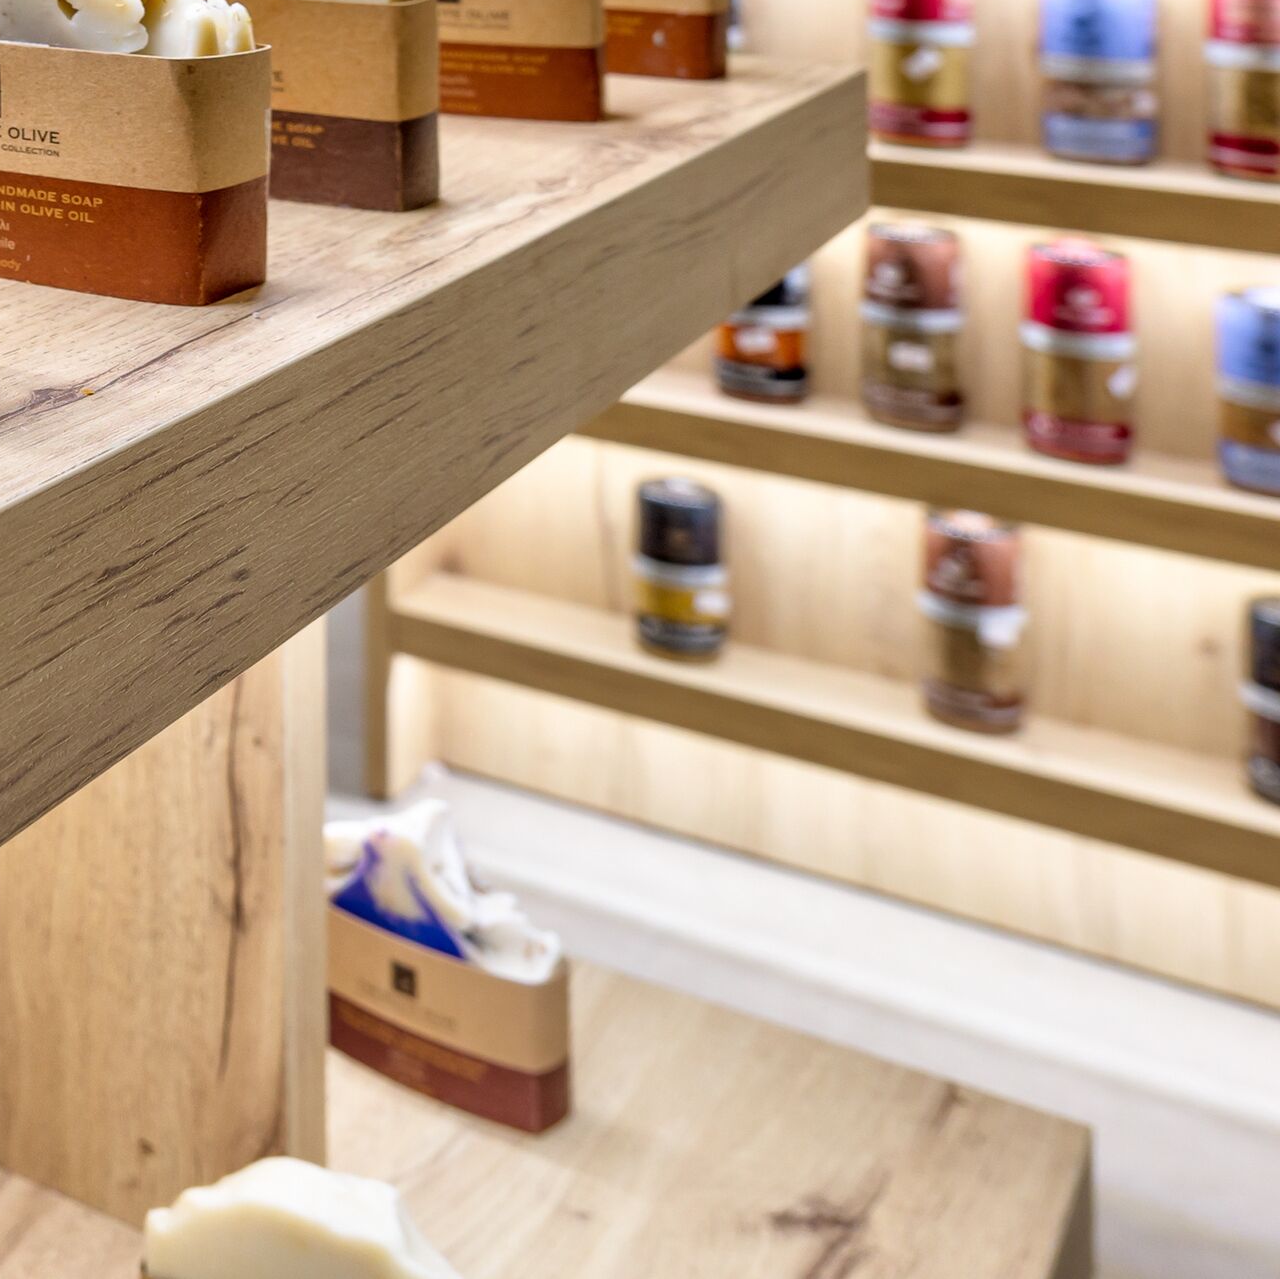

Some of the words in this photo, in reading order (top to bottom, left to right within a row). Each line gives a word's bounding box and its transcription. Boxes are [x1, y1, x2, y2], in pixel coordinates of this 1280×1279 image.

[8, 127, 60, 145] OLIVE
[1, 144, 61, 158] COLLECTION
[61, 193, 103, 208] SOAP
[20, 203, 64, 220] OLIVE
[68, 211, 95, 224] OIL
